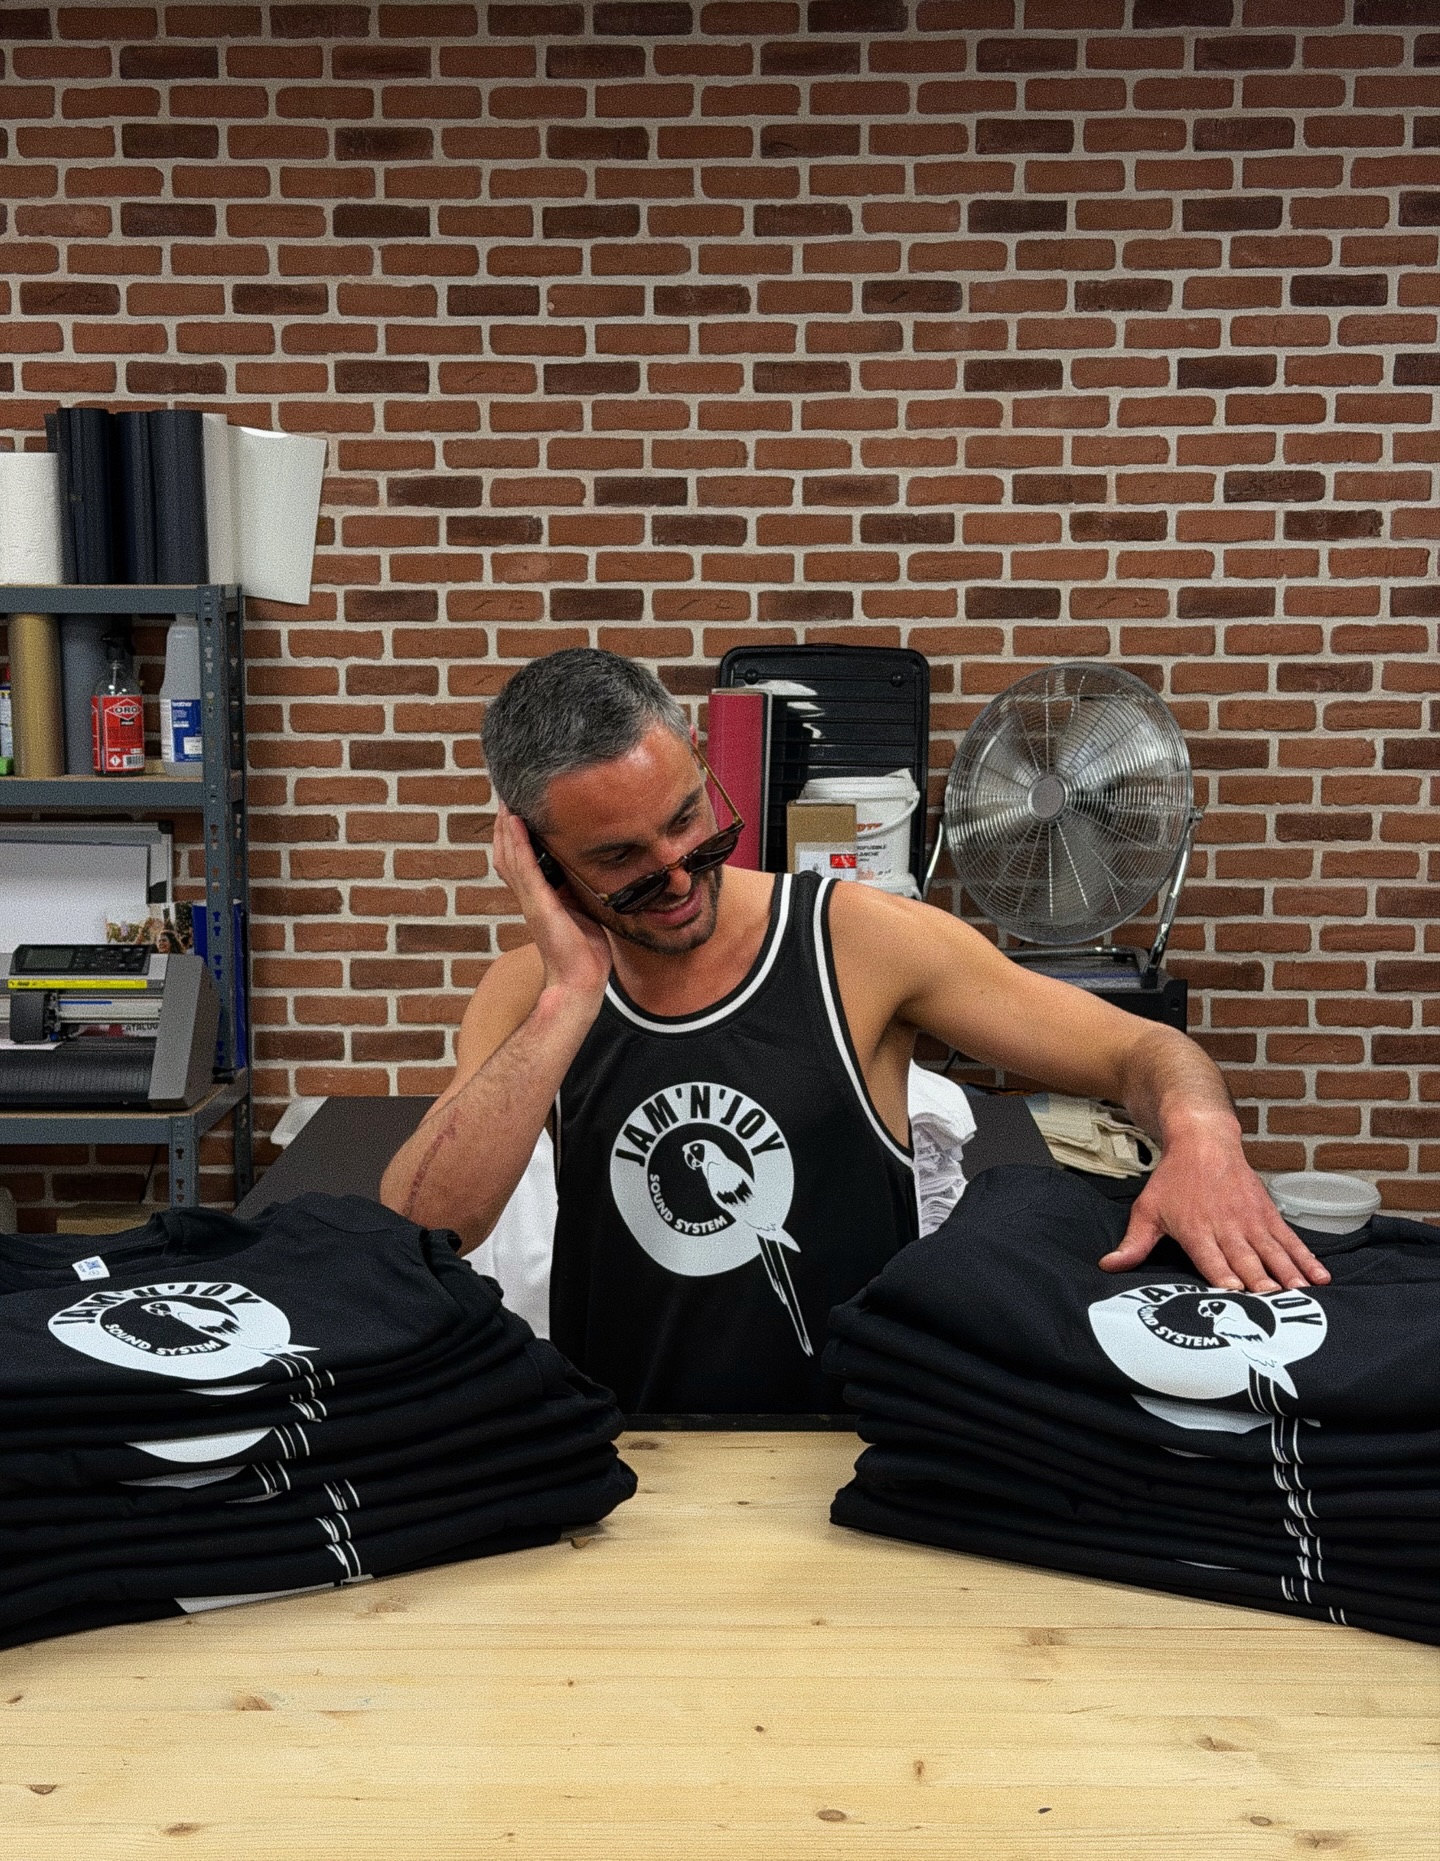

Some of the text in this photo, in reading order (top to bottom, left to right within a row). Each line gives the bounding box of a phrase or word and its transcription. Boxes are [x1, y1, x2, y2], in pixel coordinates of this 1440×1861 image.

[614, 1084, 786, 1168] JAM'N'JOY
[649, 1173, 728, 1234] SOUND SYSTEM
[104, 1323, 222, 1356] SOUND SYSTEM
[1154, 1325, 1220, 1347] SYSTEM
